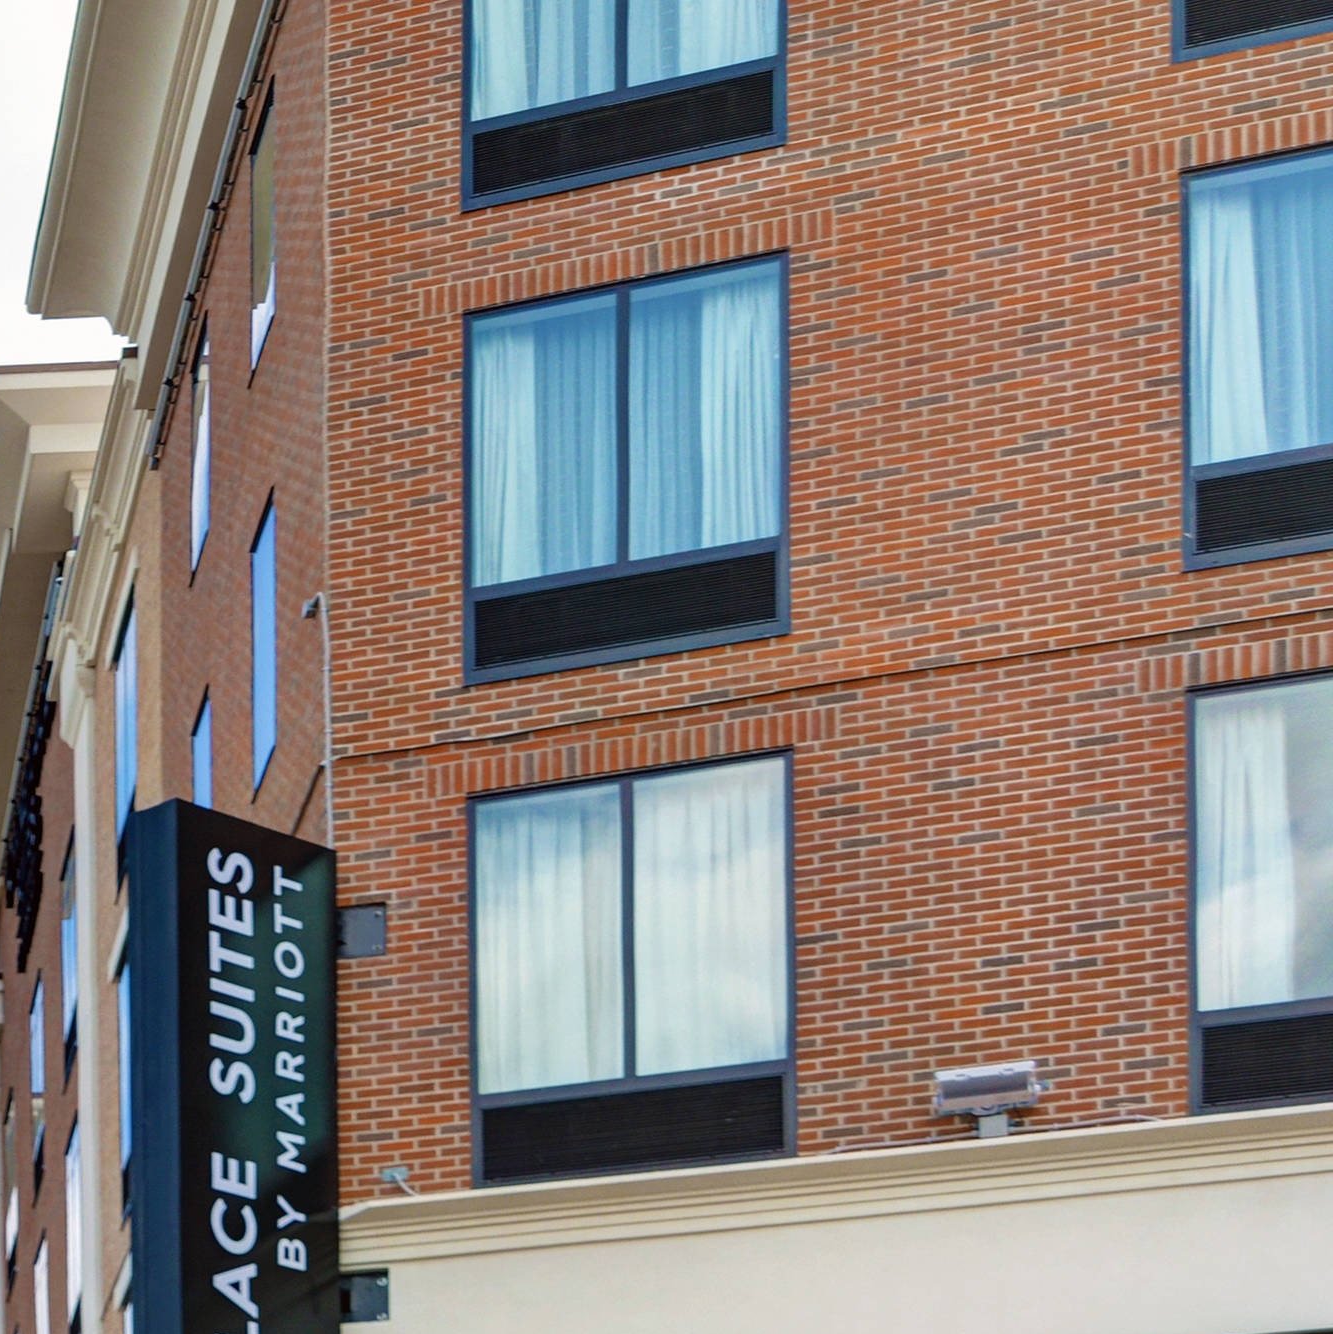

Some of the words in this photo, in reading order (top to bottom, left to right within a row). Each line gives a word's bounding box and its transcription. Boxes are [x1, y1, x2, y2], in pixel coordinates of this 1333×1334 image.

[207, 847, 256, 1104] SUITES
[273, 865, 307, 1174] MARRIOTT
[276, 1195, 308, 1272] BY
